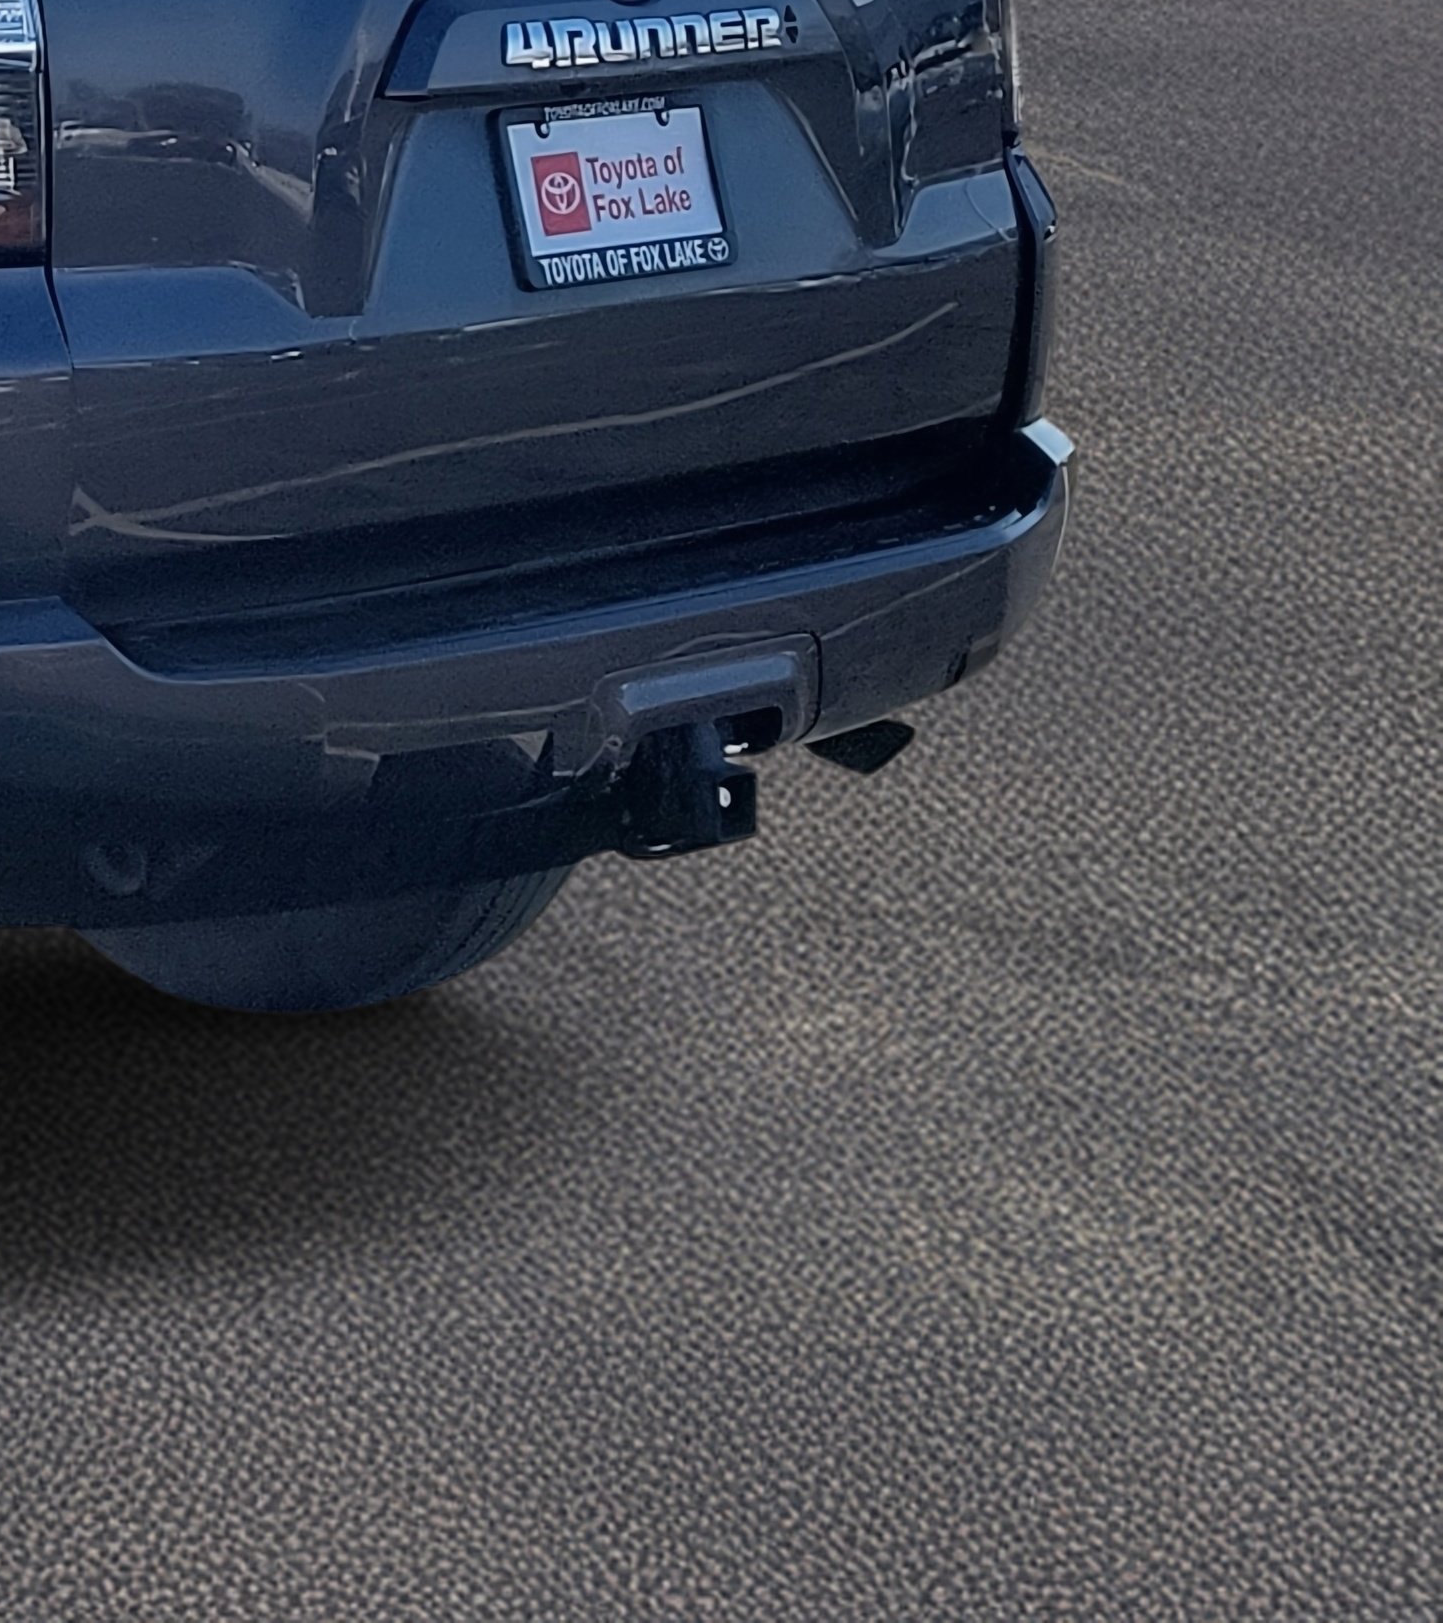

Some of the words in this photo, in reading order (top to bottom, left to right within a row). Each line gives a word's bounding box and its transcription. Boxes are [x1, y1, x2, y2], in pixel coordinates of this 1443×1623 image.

[505, 8, 782, 68] 4RUNNER
[585, 153, 658, 189] Toyota
[663, 146, 685, 175] of
[593, 194, 636, 222] Fox
[638, 184, 692, 215] Lake
[539, 252, 606, 286] TOYOTA
[606, 249, 628, 276] OF
[629, 243, 665, 274] FOX
[663, 239, 707, 269] LAKE
